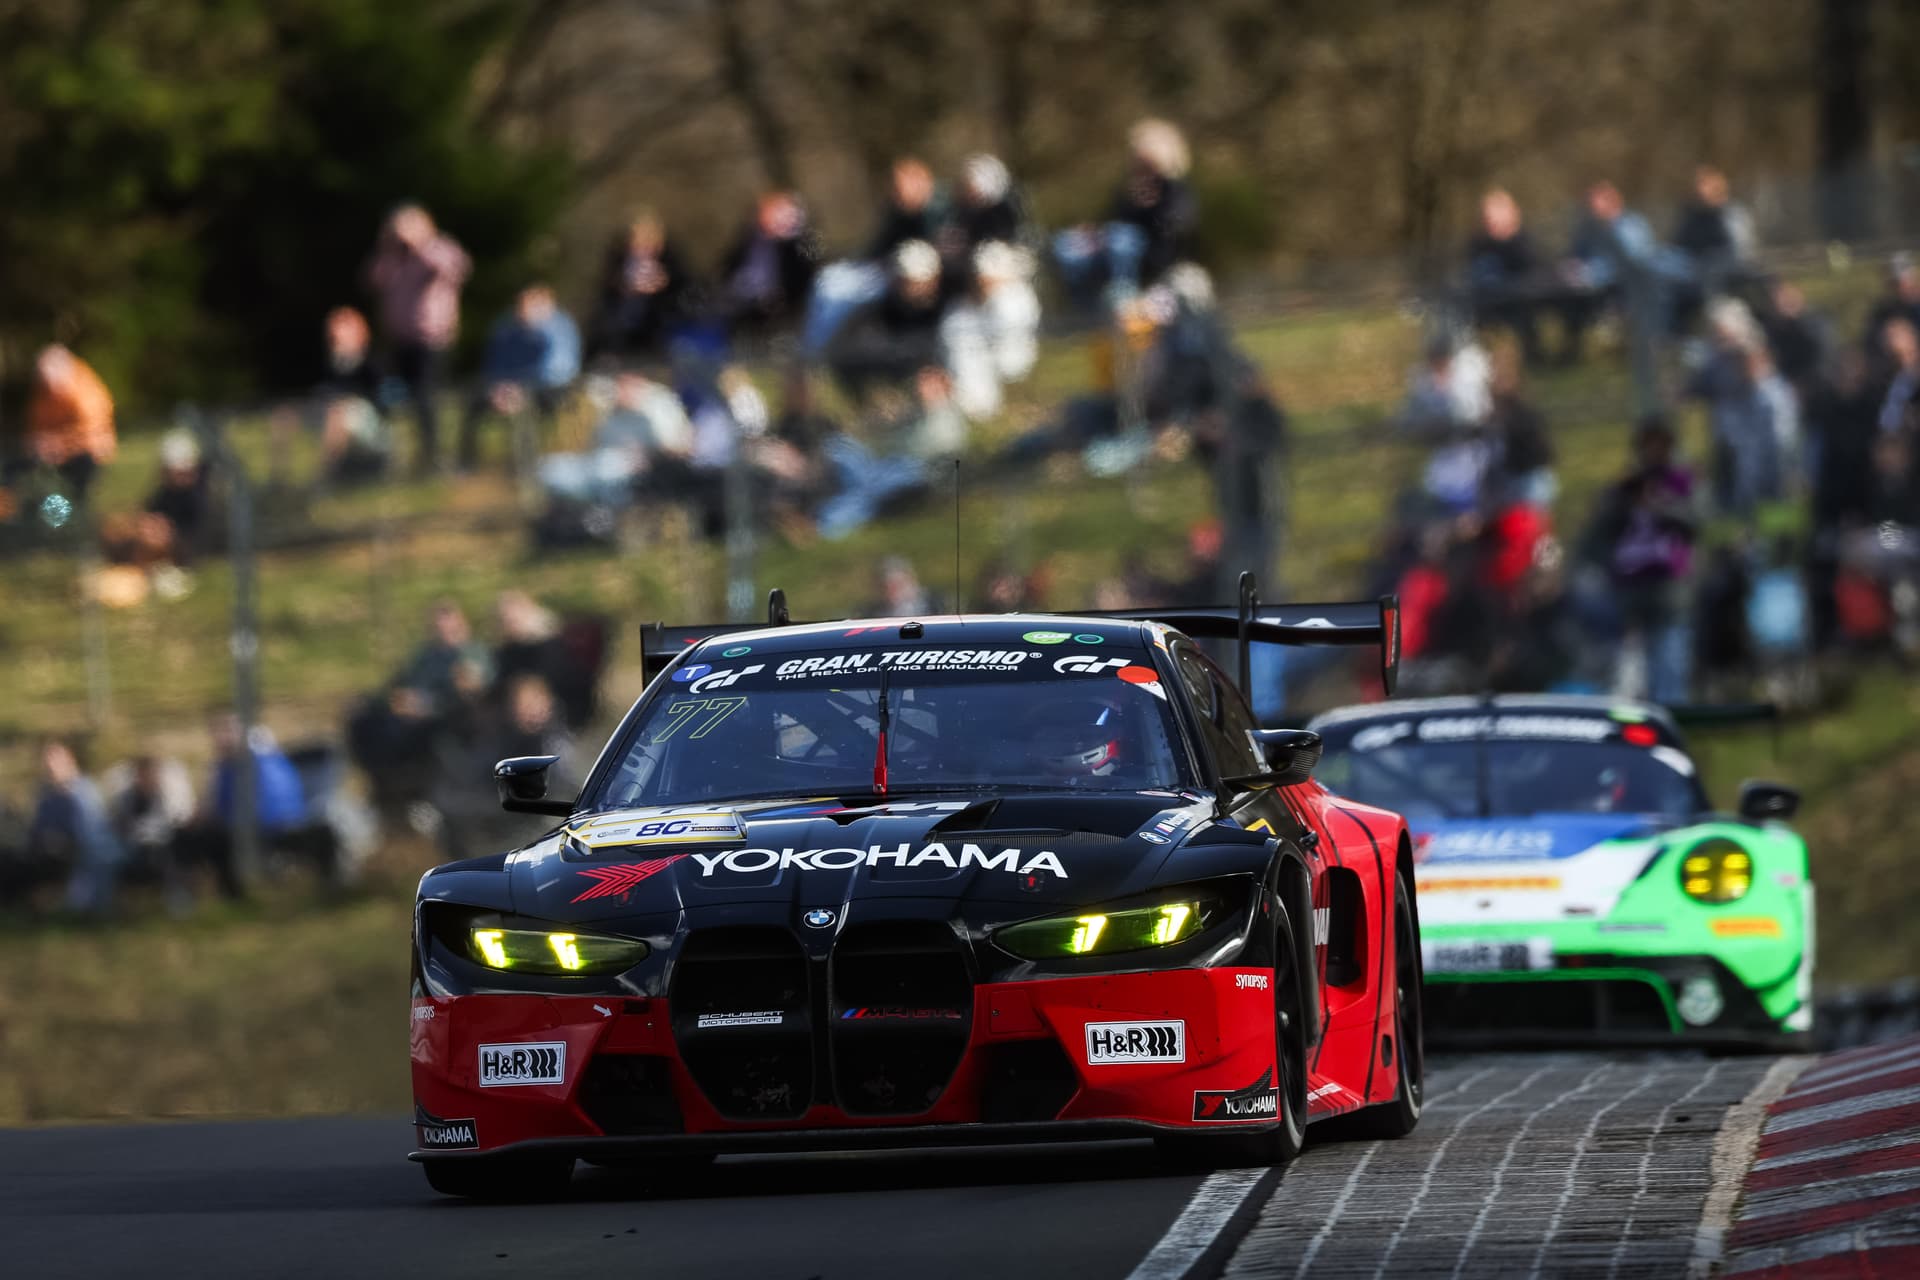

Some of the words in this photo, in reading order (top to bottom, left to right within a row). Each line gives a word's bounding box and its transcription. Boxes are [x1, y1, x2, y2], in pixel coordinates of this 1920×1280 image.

[684, 665, 706, 680] T
[775, 653, 873, 675] GRAN
[776, 673, 807, 681] THE
[811, 669, 853, 678] REAL
[856, 665, 922, 673] DRING
[653, 696, 748, 743] 77
[635, 820, 692, 837] 80
[691, 842, 1068, 879] YOKOHAMA
[698, 1010, 784, 1020] SCHUBERT
[702, 1017, 779, 1026] MOTORSPORT
[1092, 1030, 1144, 1055] H&R
[483, 1051, 528, 1078] H&R
[1224, 1095, 1277, 1115] YOKOHAMA
